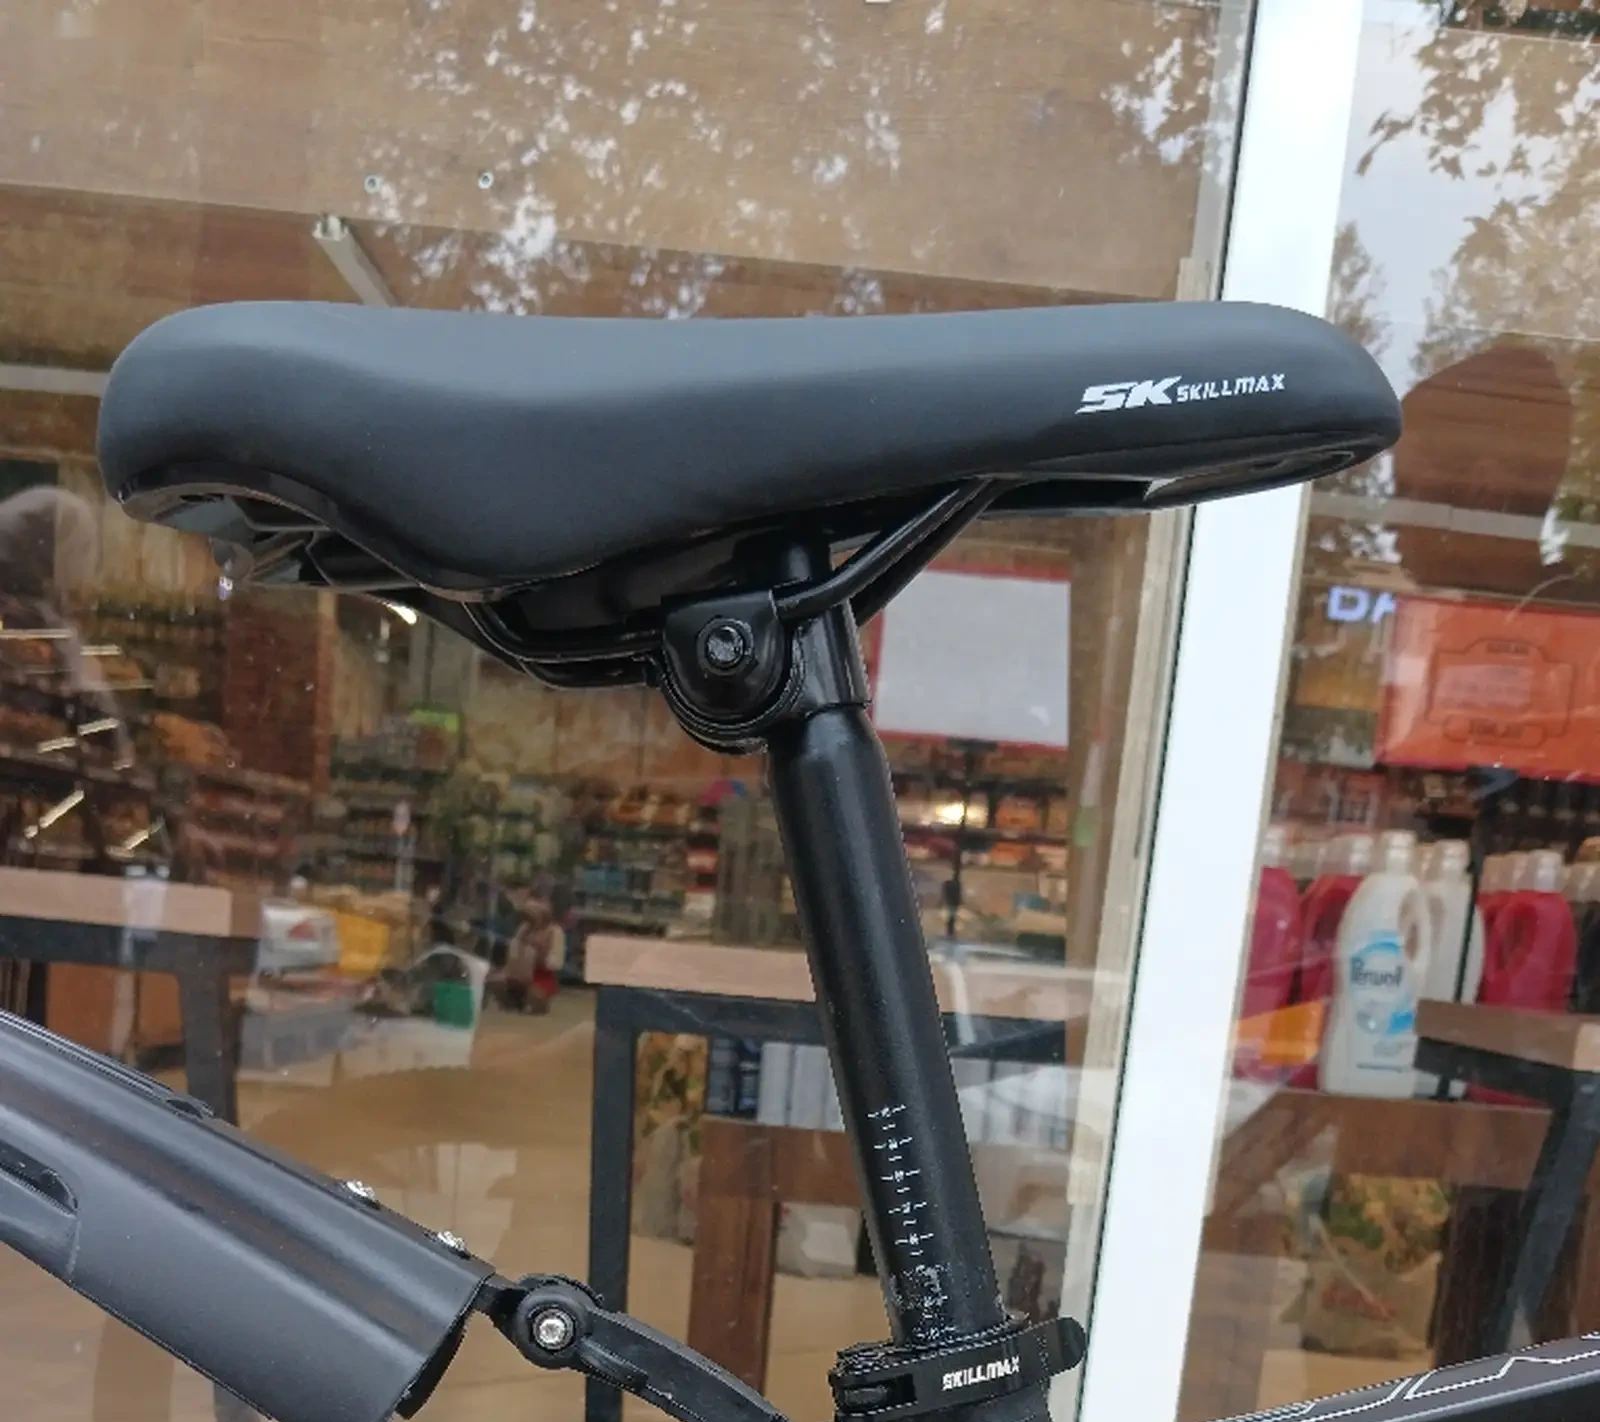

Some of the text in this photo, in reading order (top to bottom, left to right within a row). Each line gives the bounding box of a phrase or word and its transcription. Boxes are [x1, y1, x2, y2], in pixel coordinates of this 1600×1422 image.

[1075, 372, 1286, 414] SK SKILLMAX
[942, 1356, 1020, 1391] SKILLMAX
